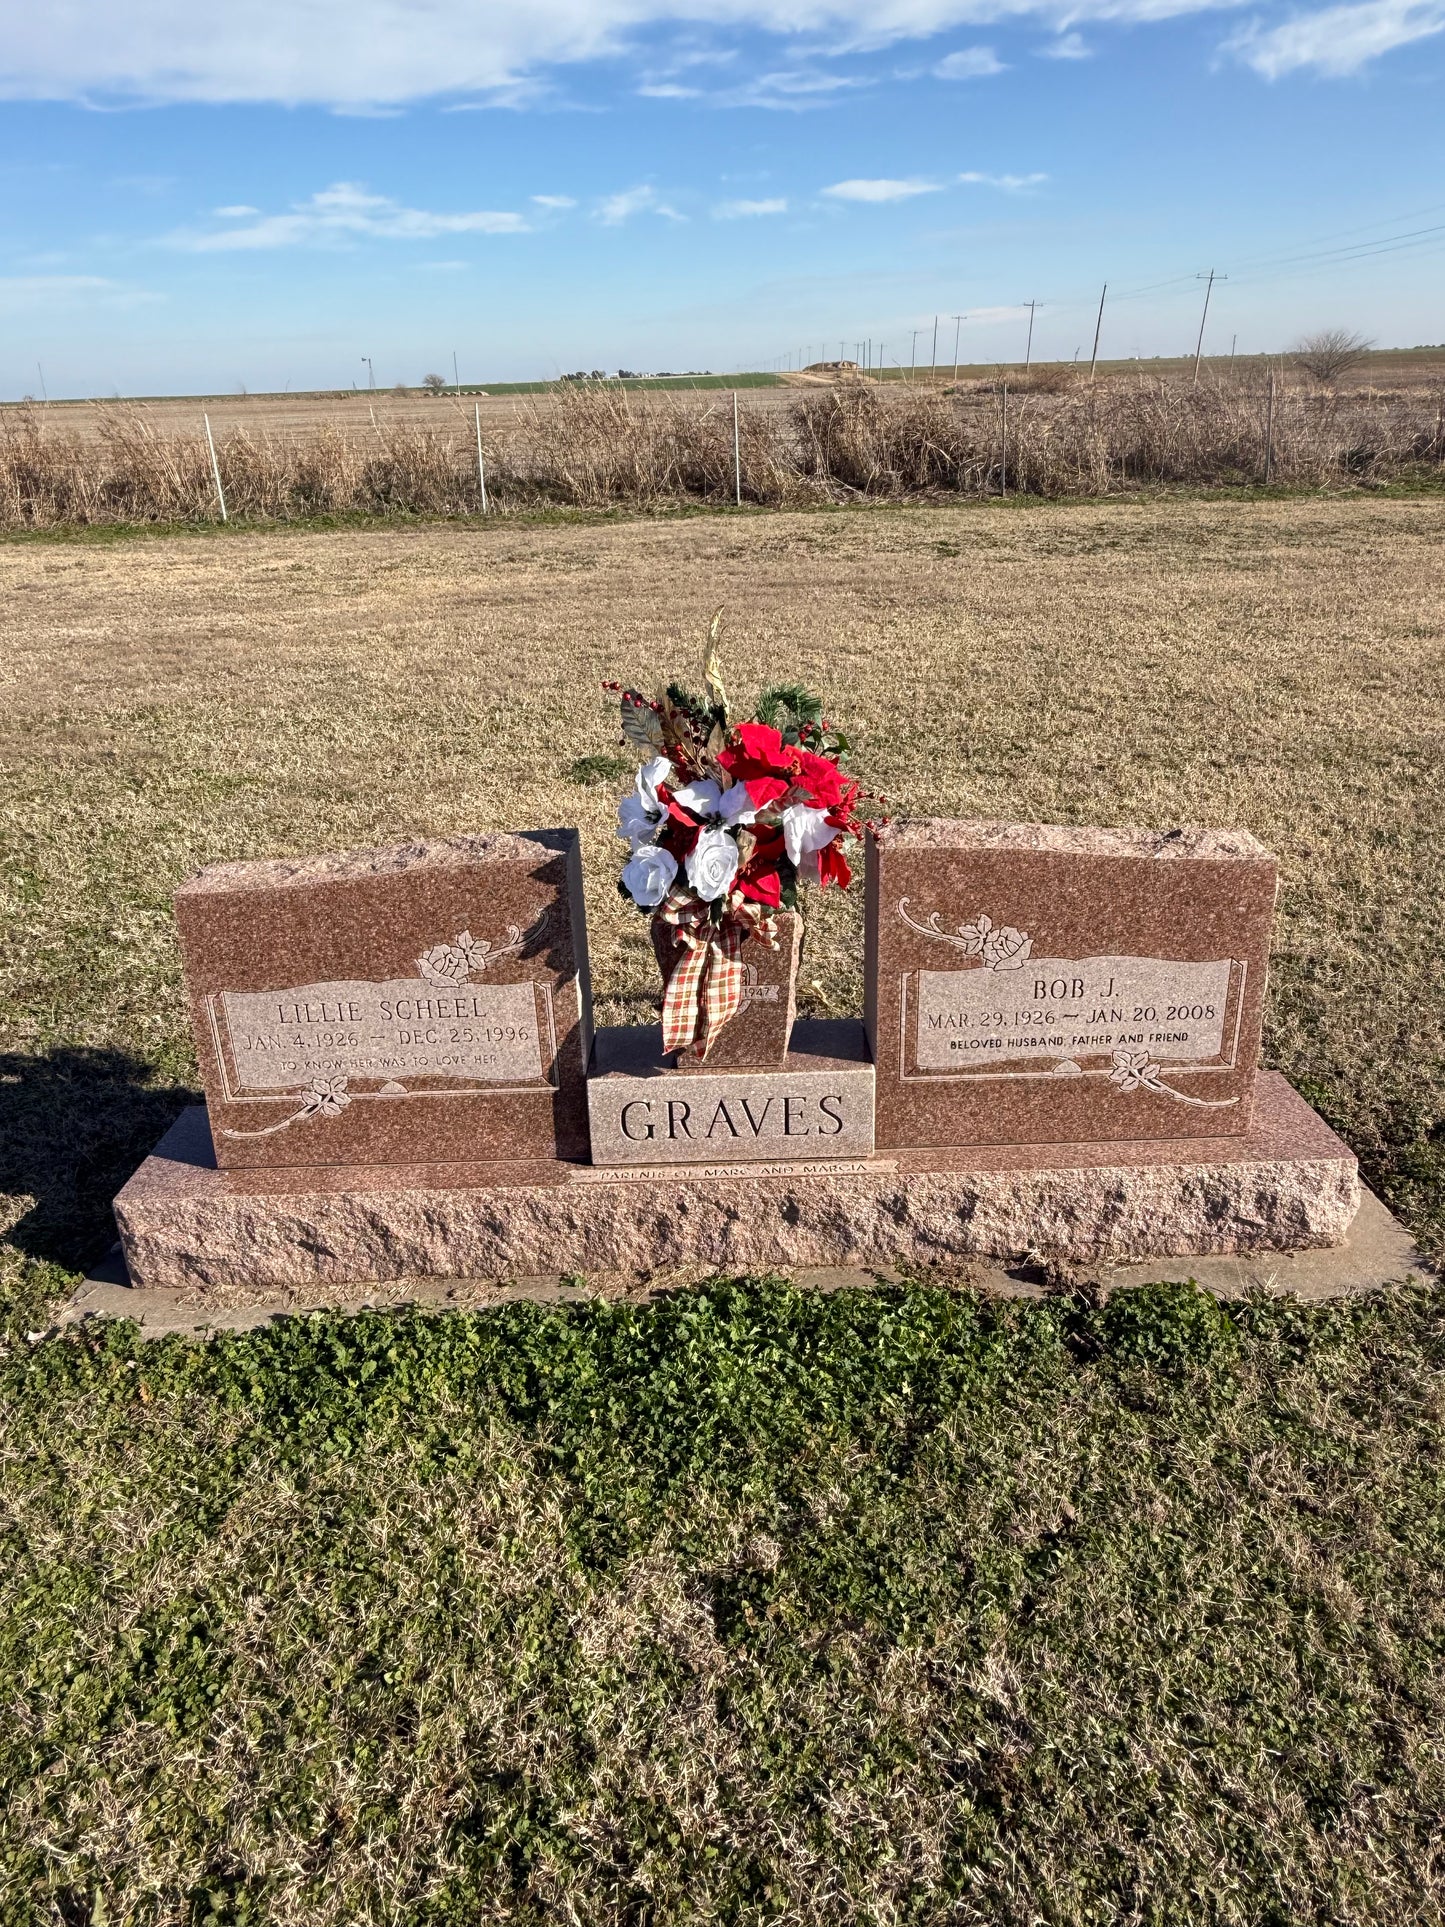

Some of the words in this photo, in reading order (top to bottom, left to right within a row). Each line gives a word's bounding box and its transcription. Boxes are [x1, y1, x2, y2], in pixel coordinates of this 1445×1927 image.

[744, 987, 770, 998] 1947
[1034, 978, 1085, 1000] BOB
[1100, 978, 1120, 1000] J.
[277, 1002, 363, 1024] LILLIE
[380, 998, 488, 1020] SCHEEL
[928, 1013, 975, 1029] MAR.
[980, 1011, 1007, 1027] 29,
[1014, 1010, 1055, 1026] 1926
[1086, 1009, 1128, 1024] JAN.
[1133, 1007, 1159, 1023] 20,
[1166, 1005, 1216, 1021] 2008
[242, 1034, 287, 1051] JAN.
[315, 1032, 359, 1048] 1926
[485, 1026, 529, 1042] 1996
[950, 1038, 1002, 1050] BELOVED
[1072, 1034, 1112, 1046] FATHER
[1118, 1033, 1144, 1044] AND
[1149, 1031, 1188, 1043] FRIEND
[281, 1061, 297, 1071] TO
[305, 1059, 343, 1070] KNOW
[350, 1057, 373, 1068] HER
[379, 1056, 406, 1067] WAS
[413, 1055, 429, 1067] TO
[436, 1055, 466, 1066] LOVE
[474, 1054, 497, 1064] HER
[620, 1095, 843, 1140] GRAVES
[760, 1165, 795, 1175] AND
[803, 1163, 868, 1173] MARCIA
